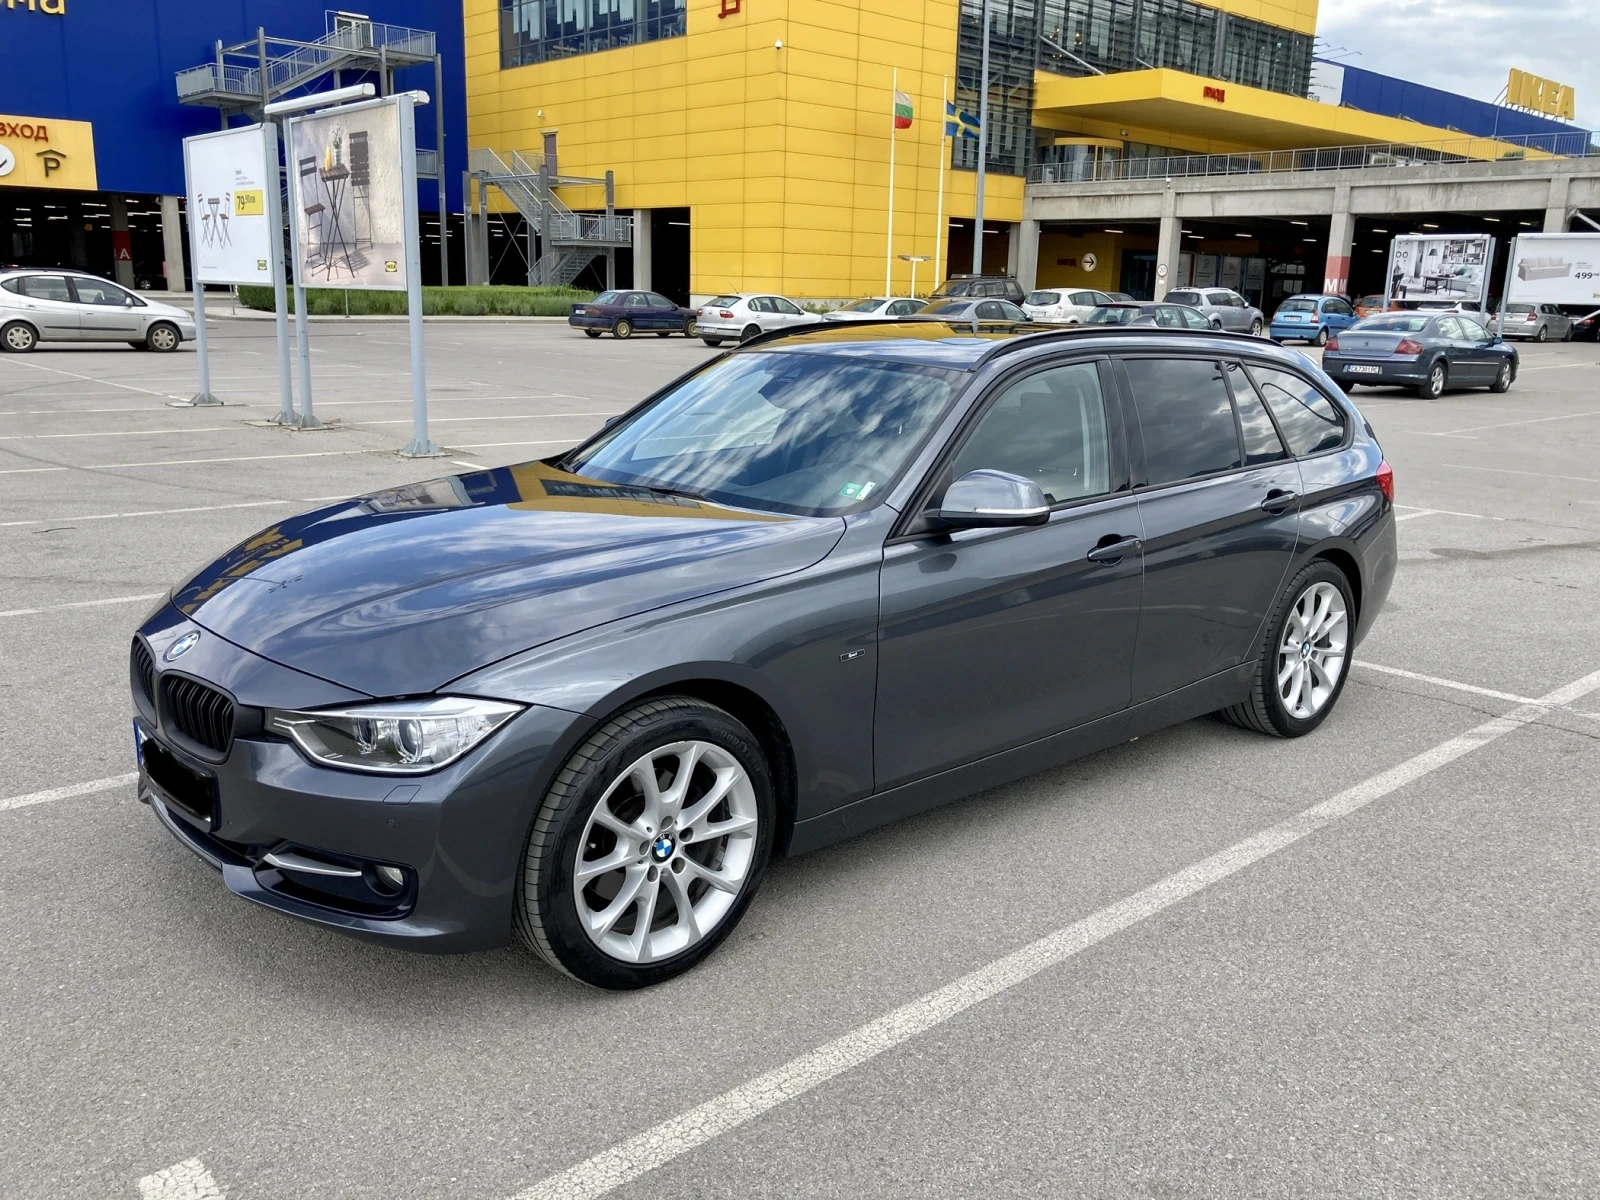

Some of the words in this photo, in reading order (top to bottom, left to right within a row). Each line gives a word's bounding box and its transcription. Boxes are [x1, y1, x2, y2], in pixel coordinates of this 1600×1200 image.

[1506, 67, 1575, 121] IKEA
[0, 122, 49, 142] ВХОД
[119, 248, 130, 260] A
[1324, 278, 1338, 292] M
